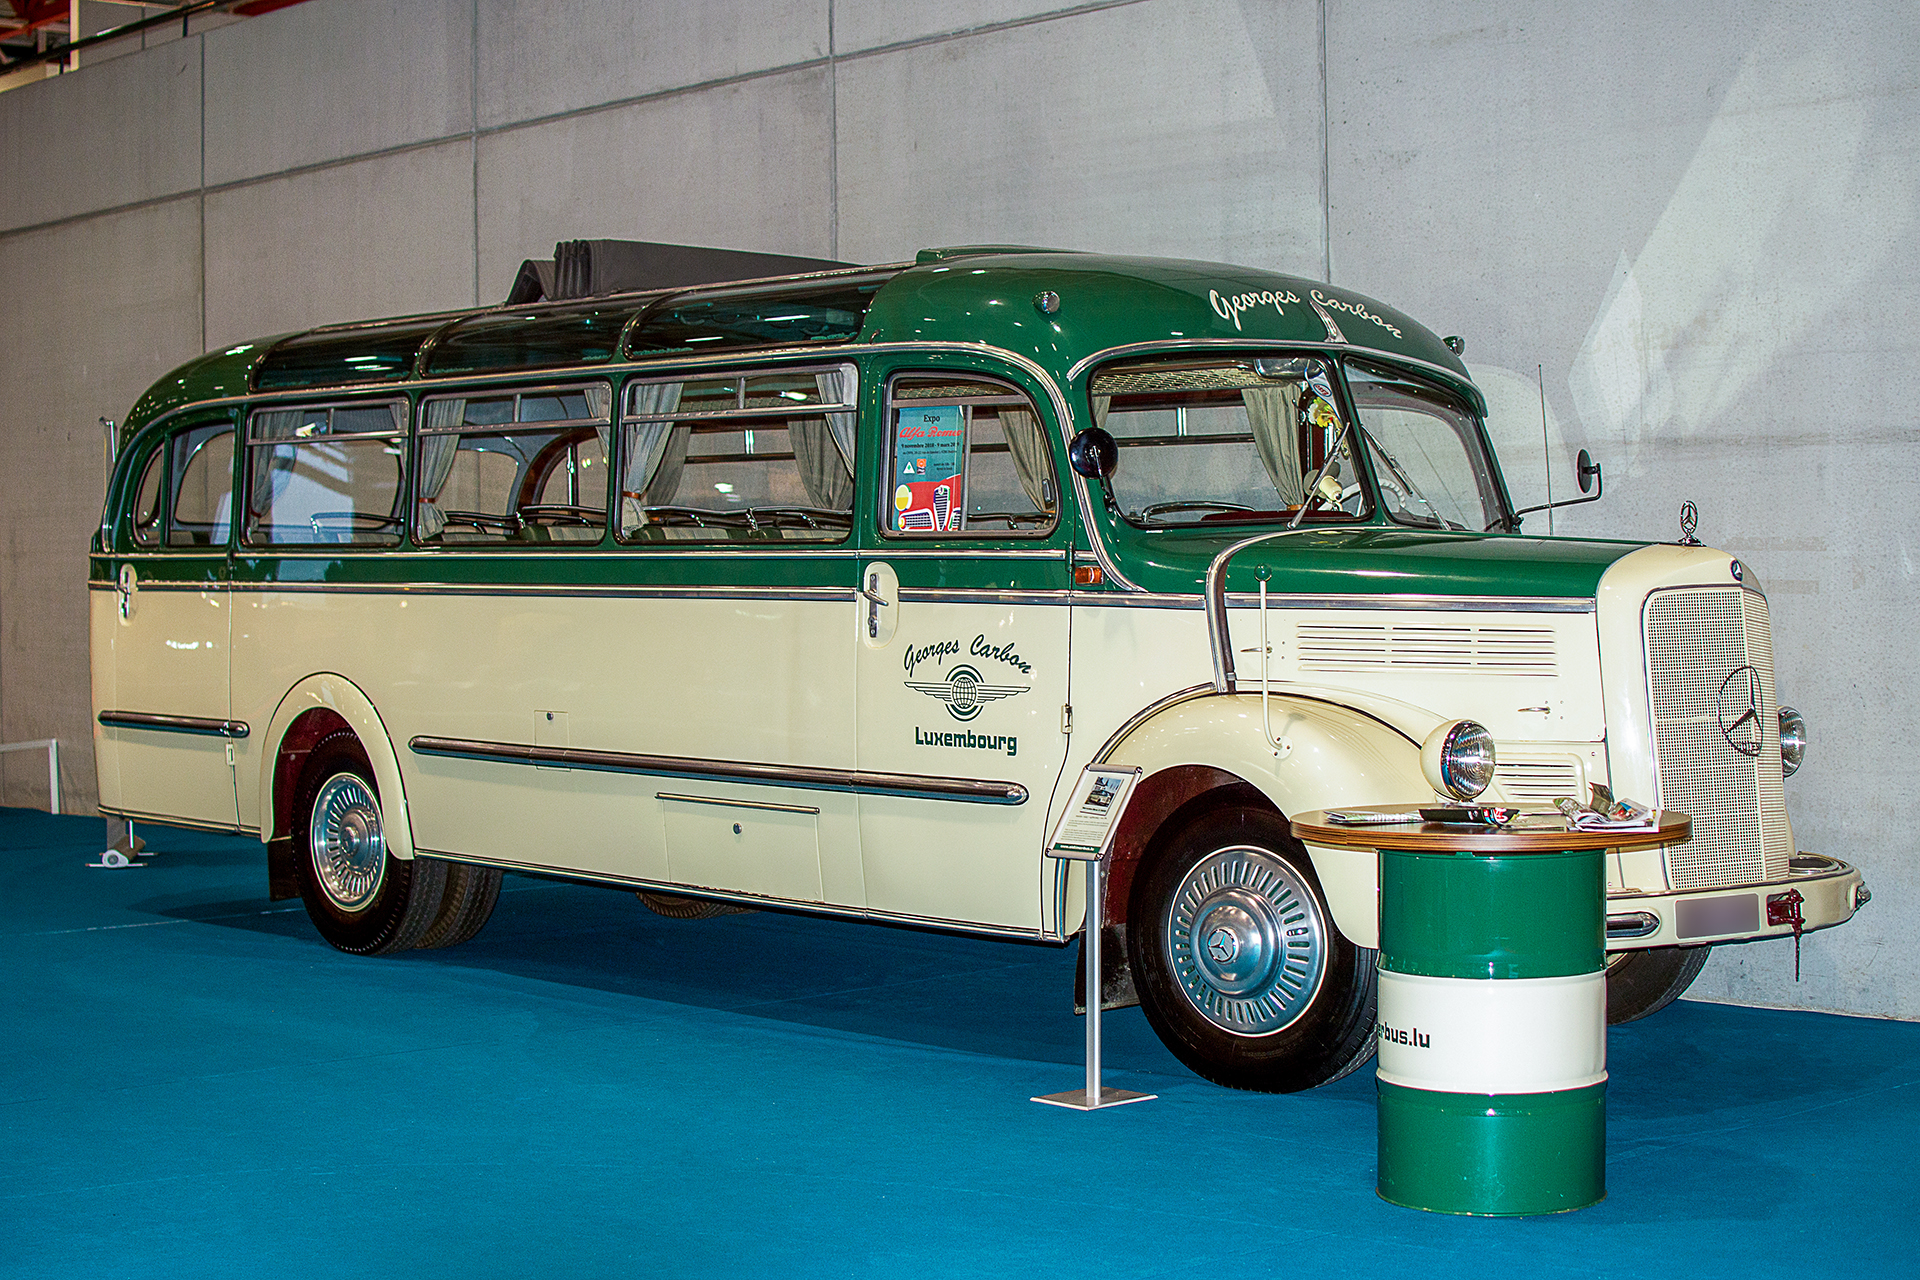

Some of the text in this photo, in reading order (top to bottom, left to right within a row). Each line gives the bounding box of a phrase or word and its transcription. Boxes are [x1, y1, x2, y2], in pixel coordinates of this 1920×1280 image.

[1208, 289, 1403, 339] Georges Carbon
[899, 425, 964, 441] Alfa Romeo
[923, 415, 941, 424] Expo
[903, 634, 1032, 678] Georges Carbon
[915, 726, 1018, 756] Luxembourg
